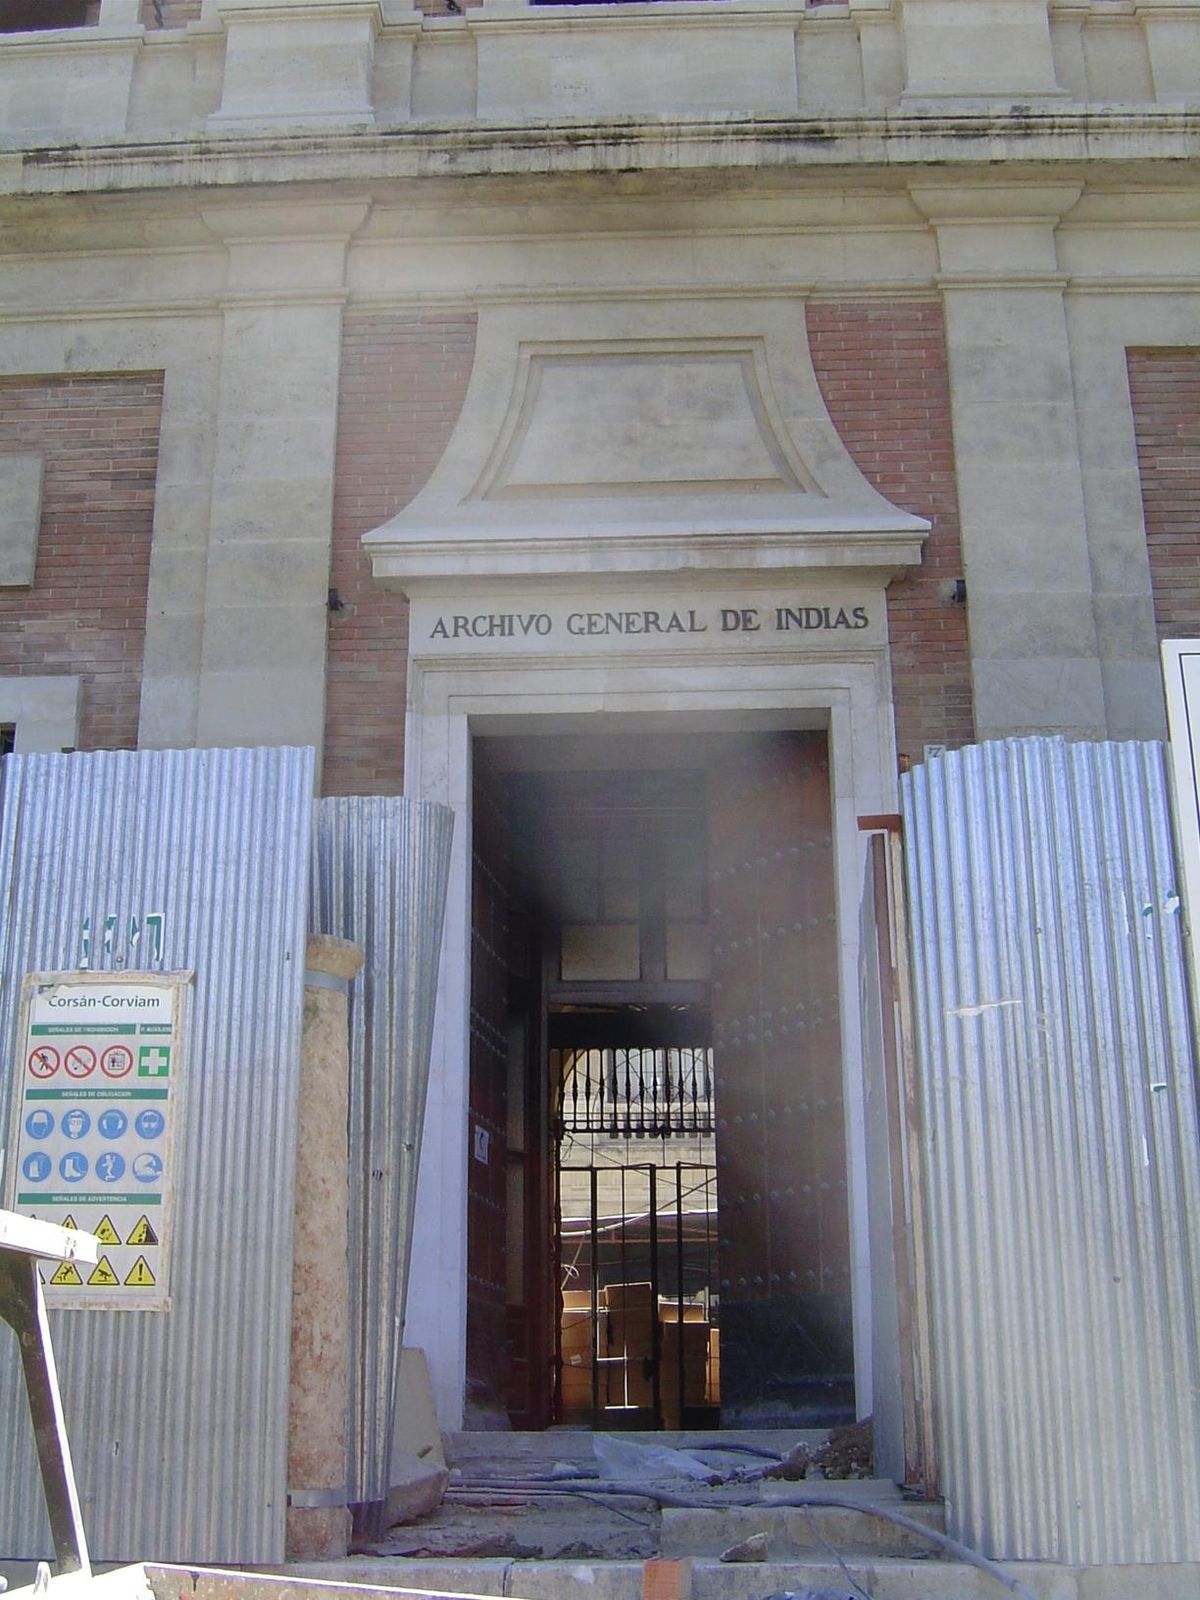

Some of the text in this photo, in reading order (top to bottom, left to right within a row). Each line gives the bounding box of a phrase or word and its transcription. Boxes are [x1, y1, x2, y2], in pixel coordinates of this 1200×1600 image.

[430, 606, 869, 639] ARCHIVO GENERAL DE INDIAS
[49, 995, 160, 1008] Corsán-Corviam
